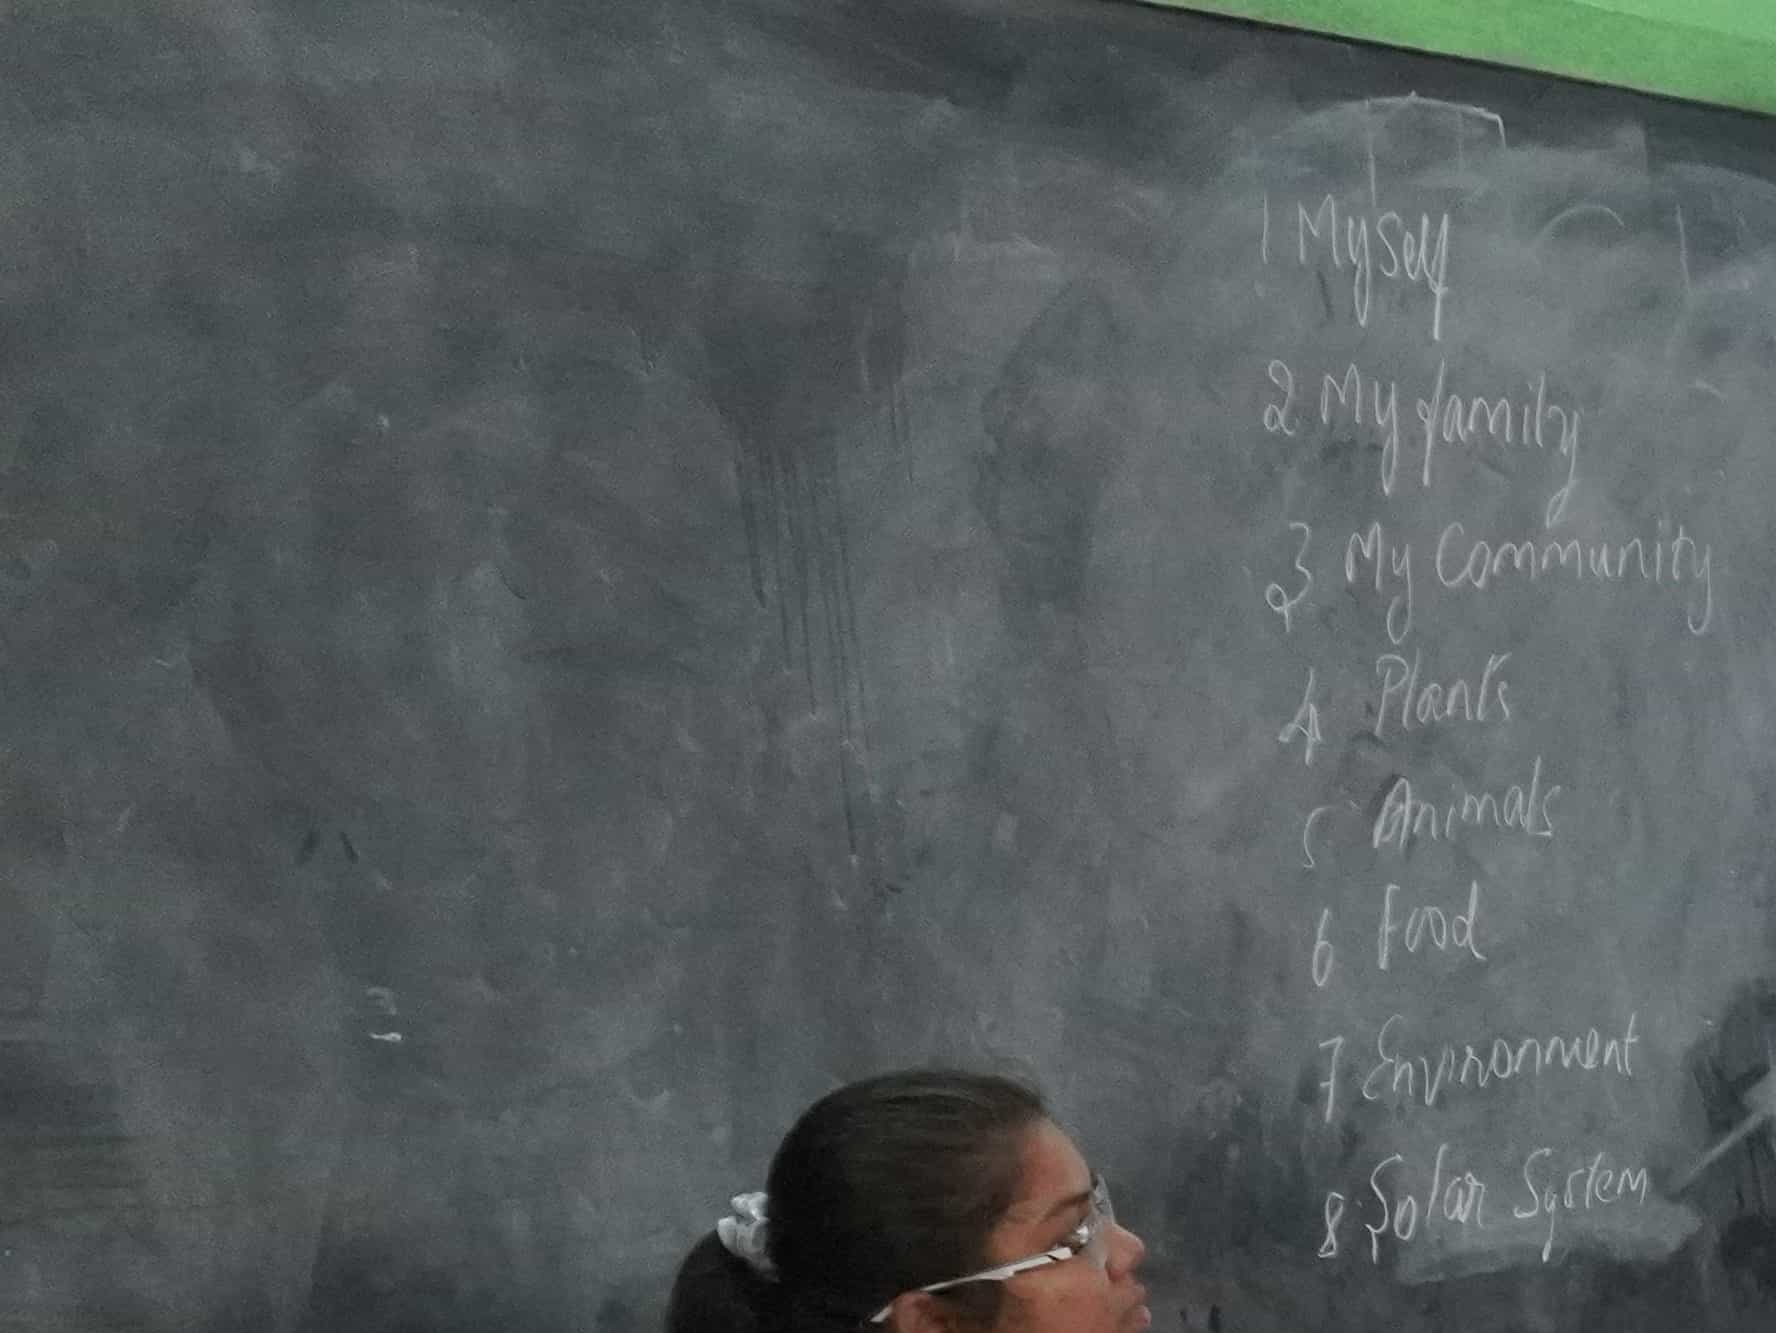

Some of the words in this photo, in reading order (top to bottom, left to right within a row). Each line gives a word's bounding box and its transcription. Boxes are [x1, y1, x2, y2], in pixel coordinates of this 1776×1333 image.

[1263, 360, 1296, 435] 2
[1321, 363, 1399, 496] My
[1265, 522, 1313, 632] 3
[1346, 522, 1412, 644] My
[1278, 669, 1321, 765] 4
[1375, 648, 1512, 736] Plants
[1312, 908, 1334, 986] 6
[1378, 881, 1487, 971] Food
[1318, 1037, 1345, 1124] 7
[1362, 1013, 1639, 1105] Environment
[1318, 1192, 1345, 1258] 8
[1365, 1143, 1488, 1263] Solar
[1513, 1148, 1648, 1263] System
